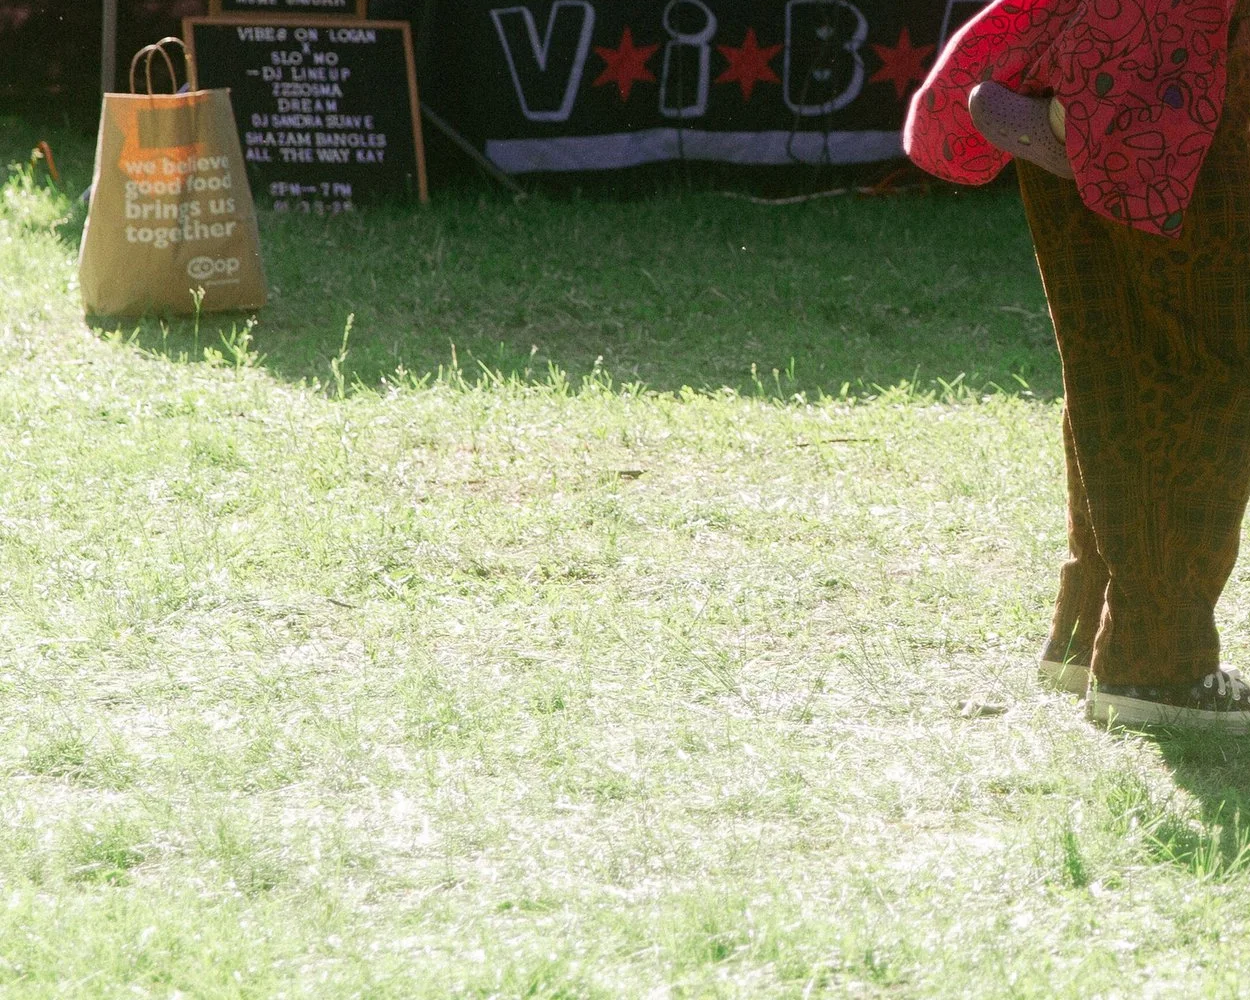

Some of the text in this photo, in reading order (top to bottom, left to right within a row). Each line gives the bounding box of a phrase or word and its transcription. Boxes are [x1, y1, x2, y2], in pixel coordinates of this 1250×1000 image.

[237, 26, 376, 43] VIBES ON LOGAN
[271, 51, 339, 66] SLO MO
[262, 66, 282, 81] DJ
[278, 98, 337, 113] DREAM
[251, 113, 269, 128] DJ
[272, 113, 323, 128] SANDRA
[245, 131, 312, 147] SHAZAM
[246, 149, 272, 162] ALL
[279, 149, 313, 163] THE
[316, 149, 350, 163] WAY
[125, 158, 157, 176] we
[125, 173, 231, 199] good food
[125, 198, 235, 224] brings us
[125, 219, 237, 249] together
